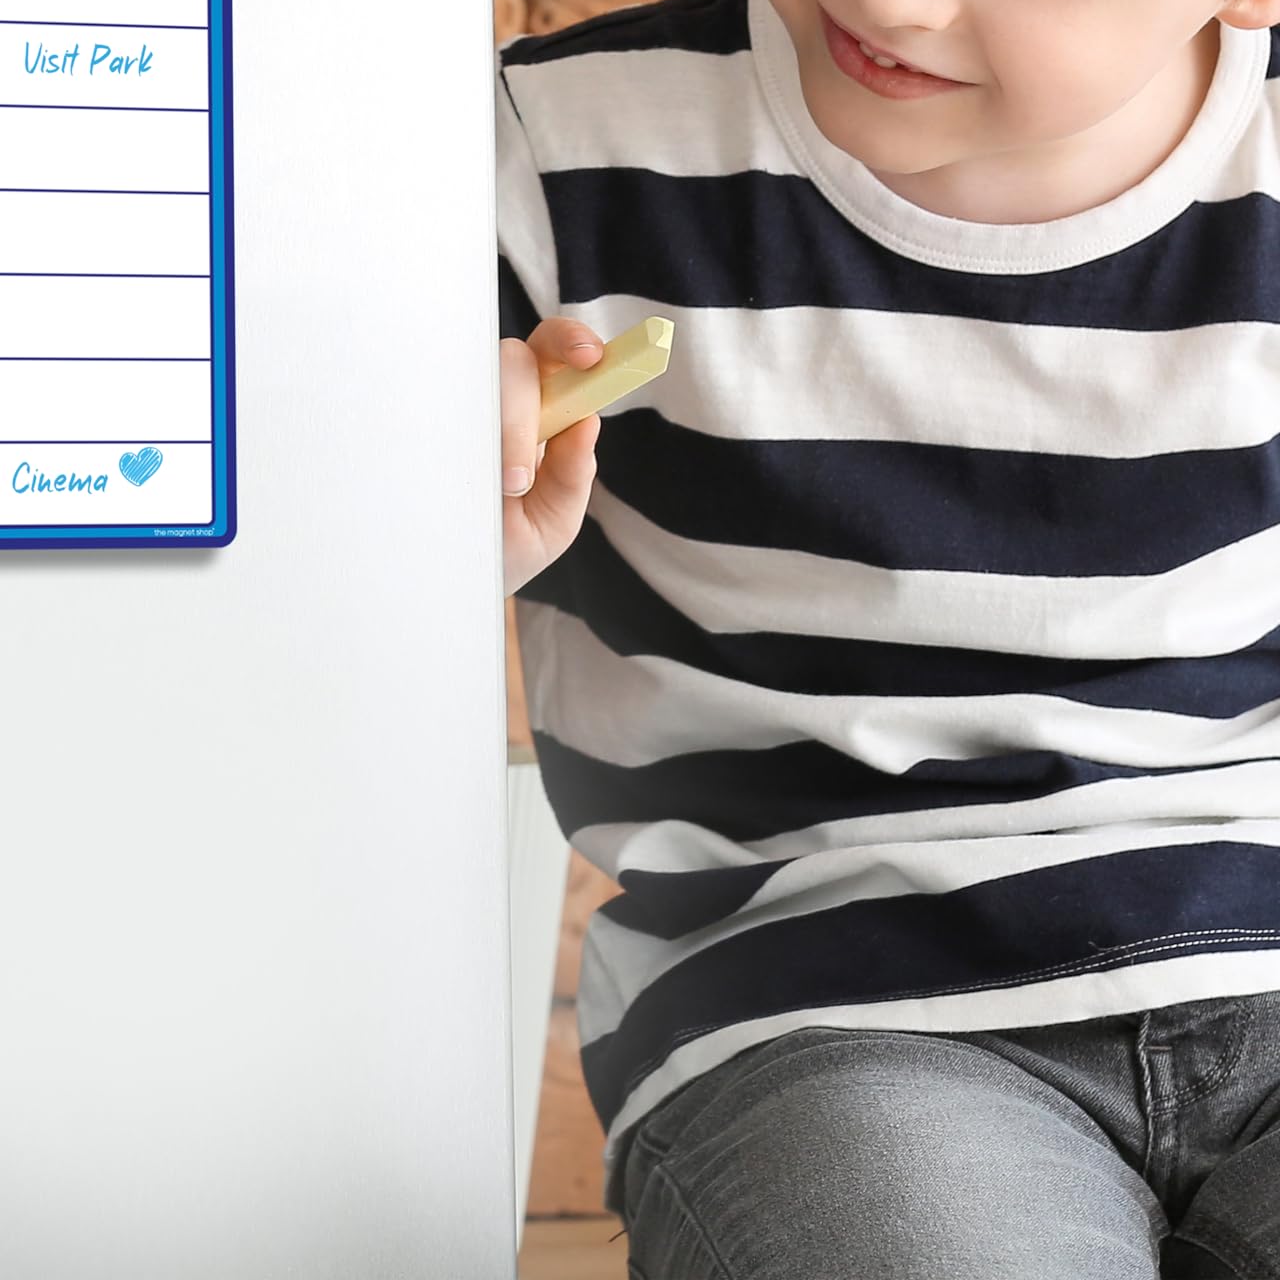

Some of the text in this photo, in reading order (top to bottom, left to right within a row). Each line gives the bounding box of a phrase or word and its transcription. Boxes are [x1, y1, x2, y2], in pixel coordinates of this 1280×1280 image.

[23, 41, 154, 76] Visit Park
[11, 461, 109, 495] Cinema
[153, 528, 214, 537] the magnet shop
